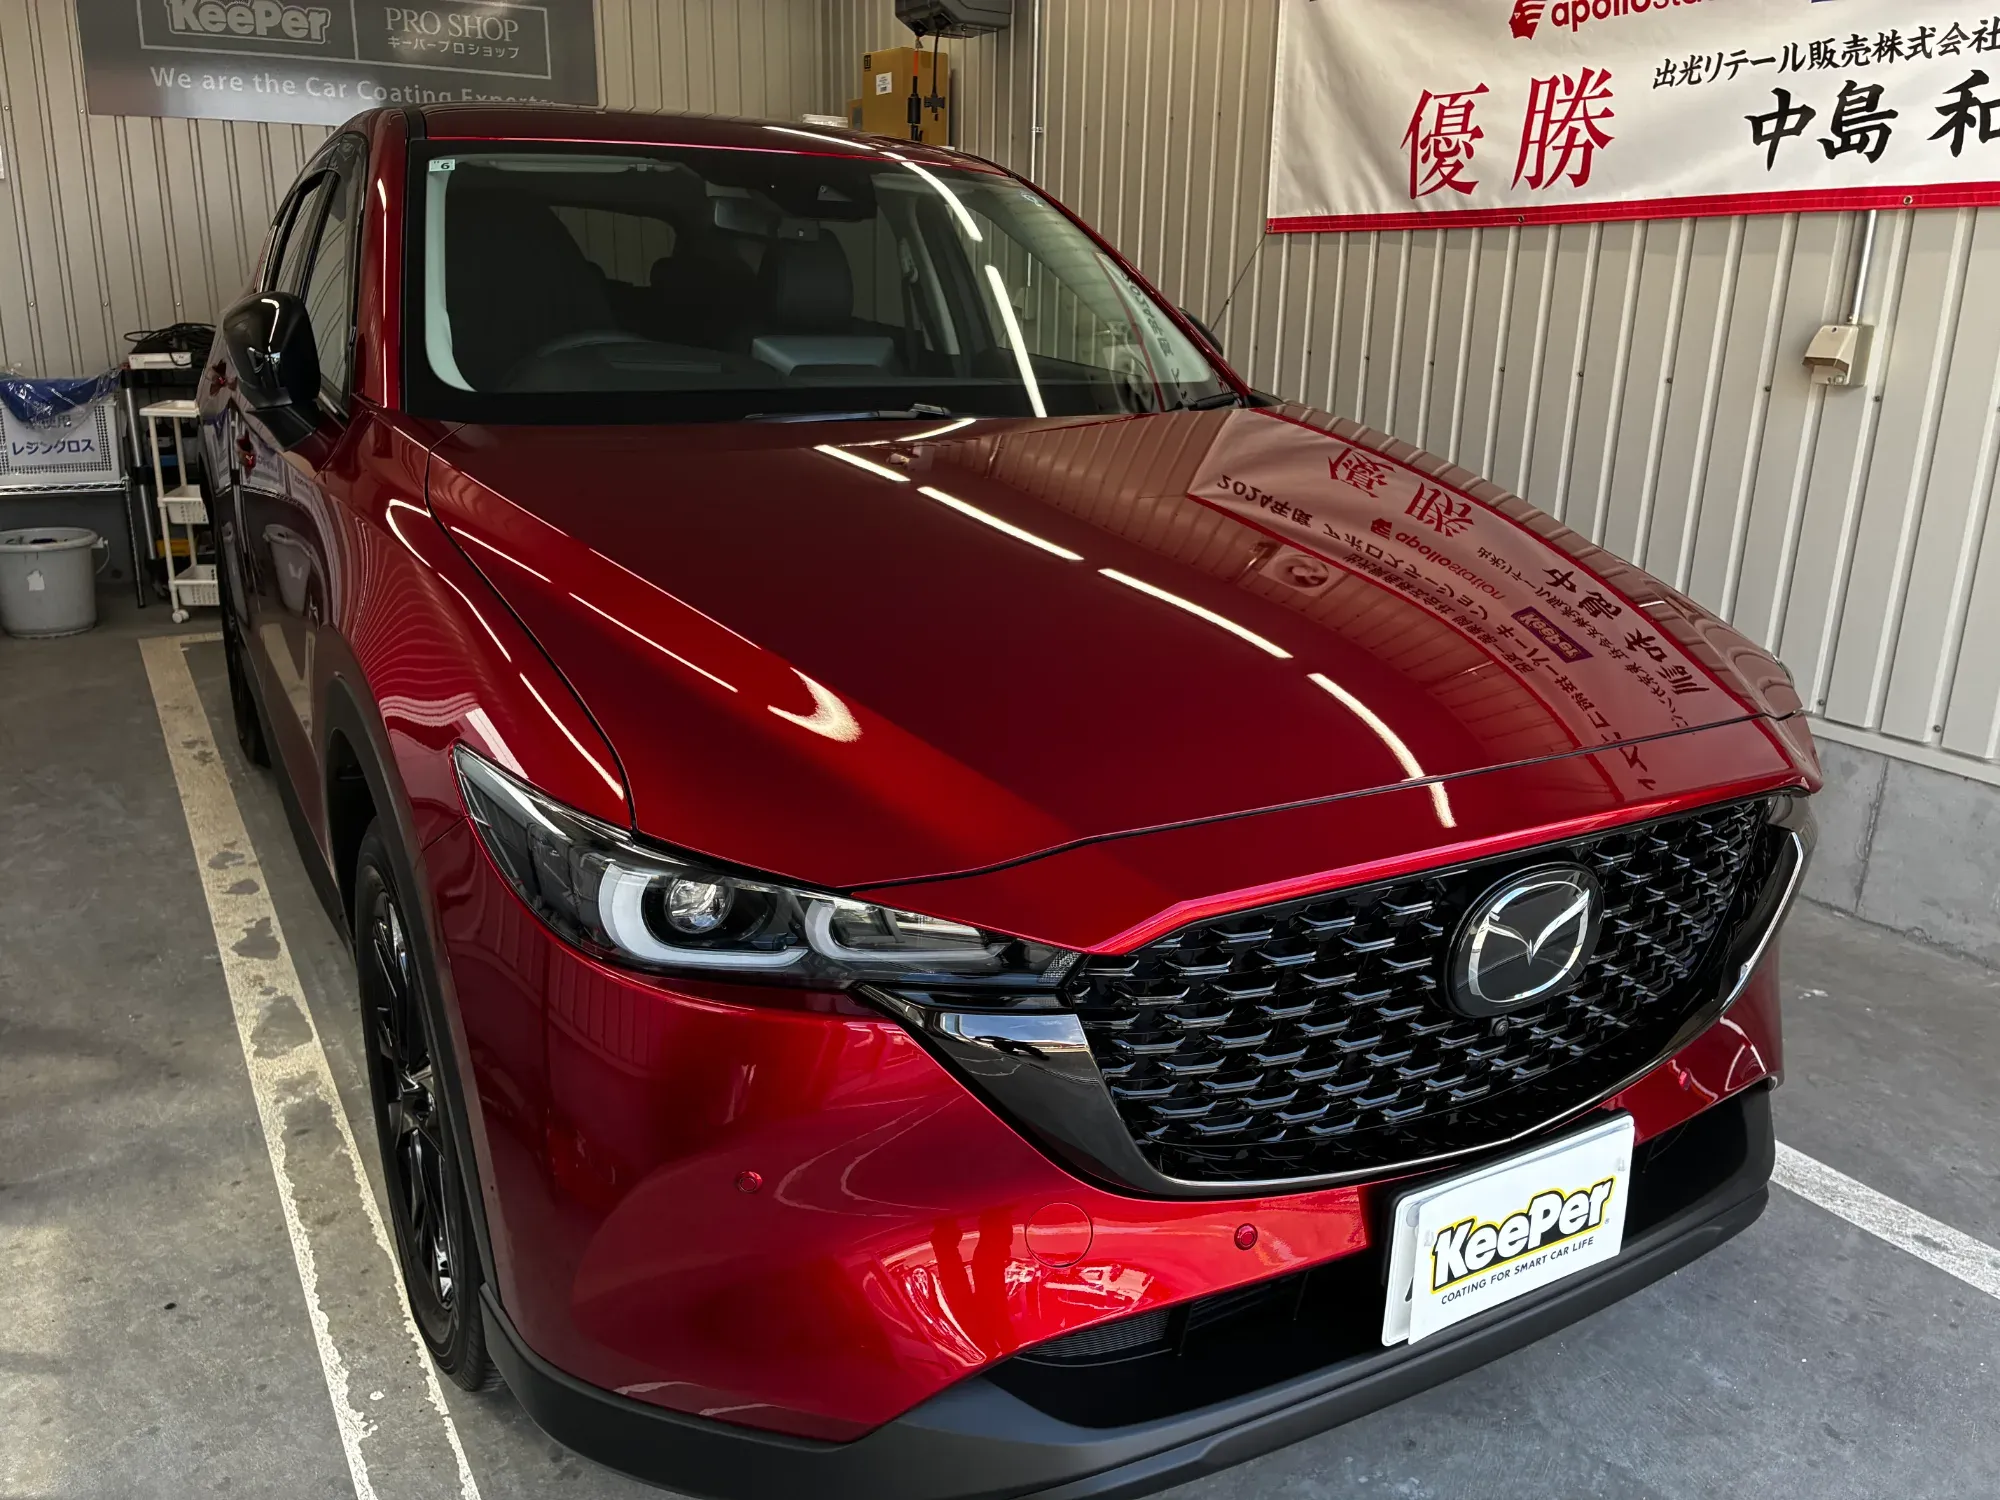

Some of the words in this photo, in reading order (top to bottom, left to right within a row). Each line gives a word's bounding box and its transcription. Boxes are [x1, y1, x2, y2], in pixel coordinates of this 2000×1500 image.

[165, 0, 330, 43] KeePer
[384, 7, 441, 35] PRO
[448, 13, 519, 42] SHOP
[1652, 18, 2000, 89] 出光リテール販売株式会社
[150, 66, 192, 89] We
[202, 74, 243, 92] are
[253, 73, 296, 95] the
[305, 76, 347, 98] Car
[1431, 1176, 1615, 1293] KeePer
[1441, 1278, 1487, 1305] COATING
[1490, 1269, 1510, 1285] FOR
[1514, 1256, 1547, 1276] SMART
[1550, 1246, 1569, 1261] CAR
[1572, 1236, 1594, 1251] LIFE
